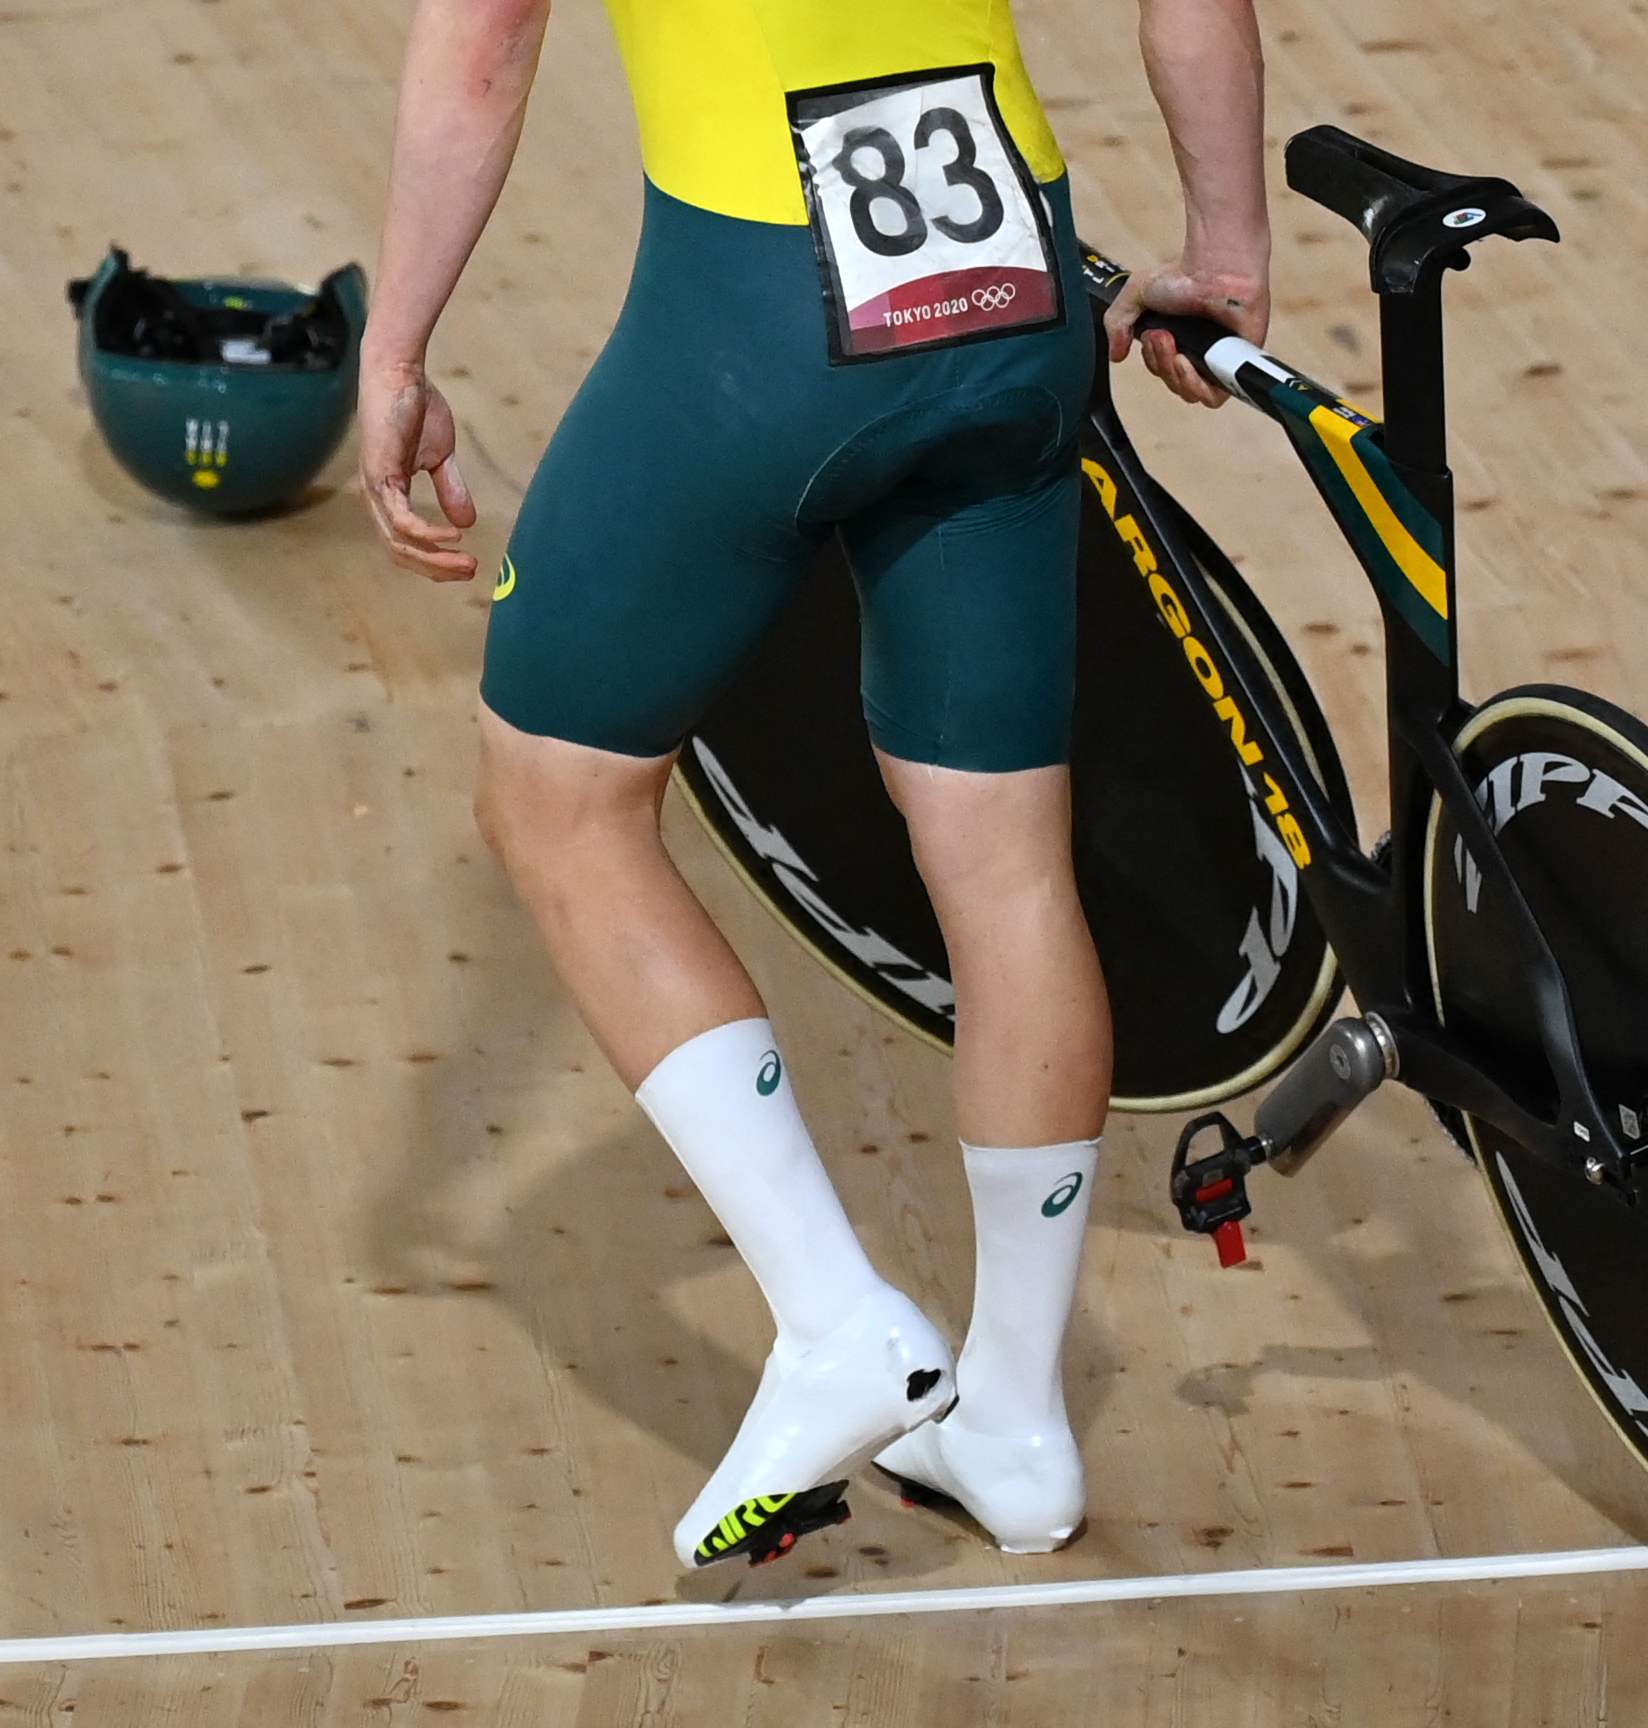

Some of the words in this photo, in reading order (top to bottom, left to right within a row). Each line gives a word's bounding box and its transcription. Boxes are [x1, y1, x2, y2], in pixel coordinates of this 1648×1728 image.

[832, 106, 1004, 257] 83
[883, 307, 932, 328] TOKYO
[933, 297, 969, 319] 2020
[1081, 456, 1263, 766] ARGON
[1263, 771, 1312, 870] 18
[691, 735, 956, 1023] IPP
